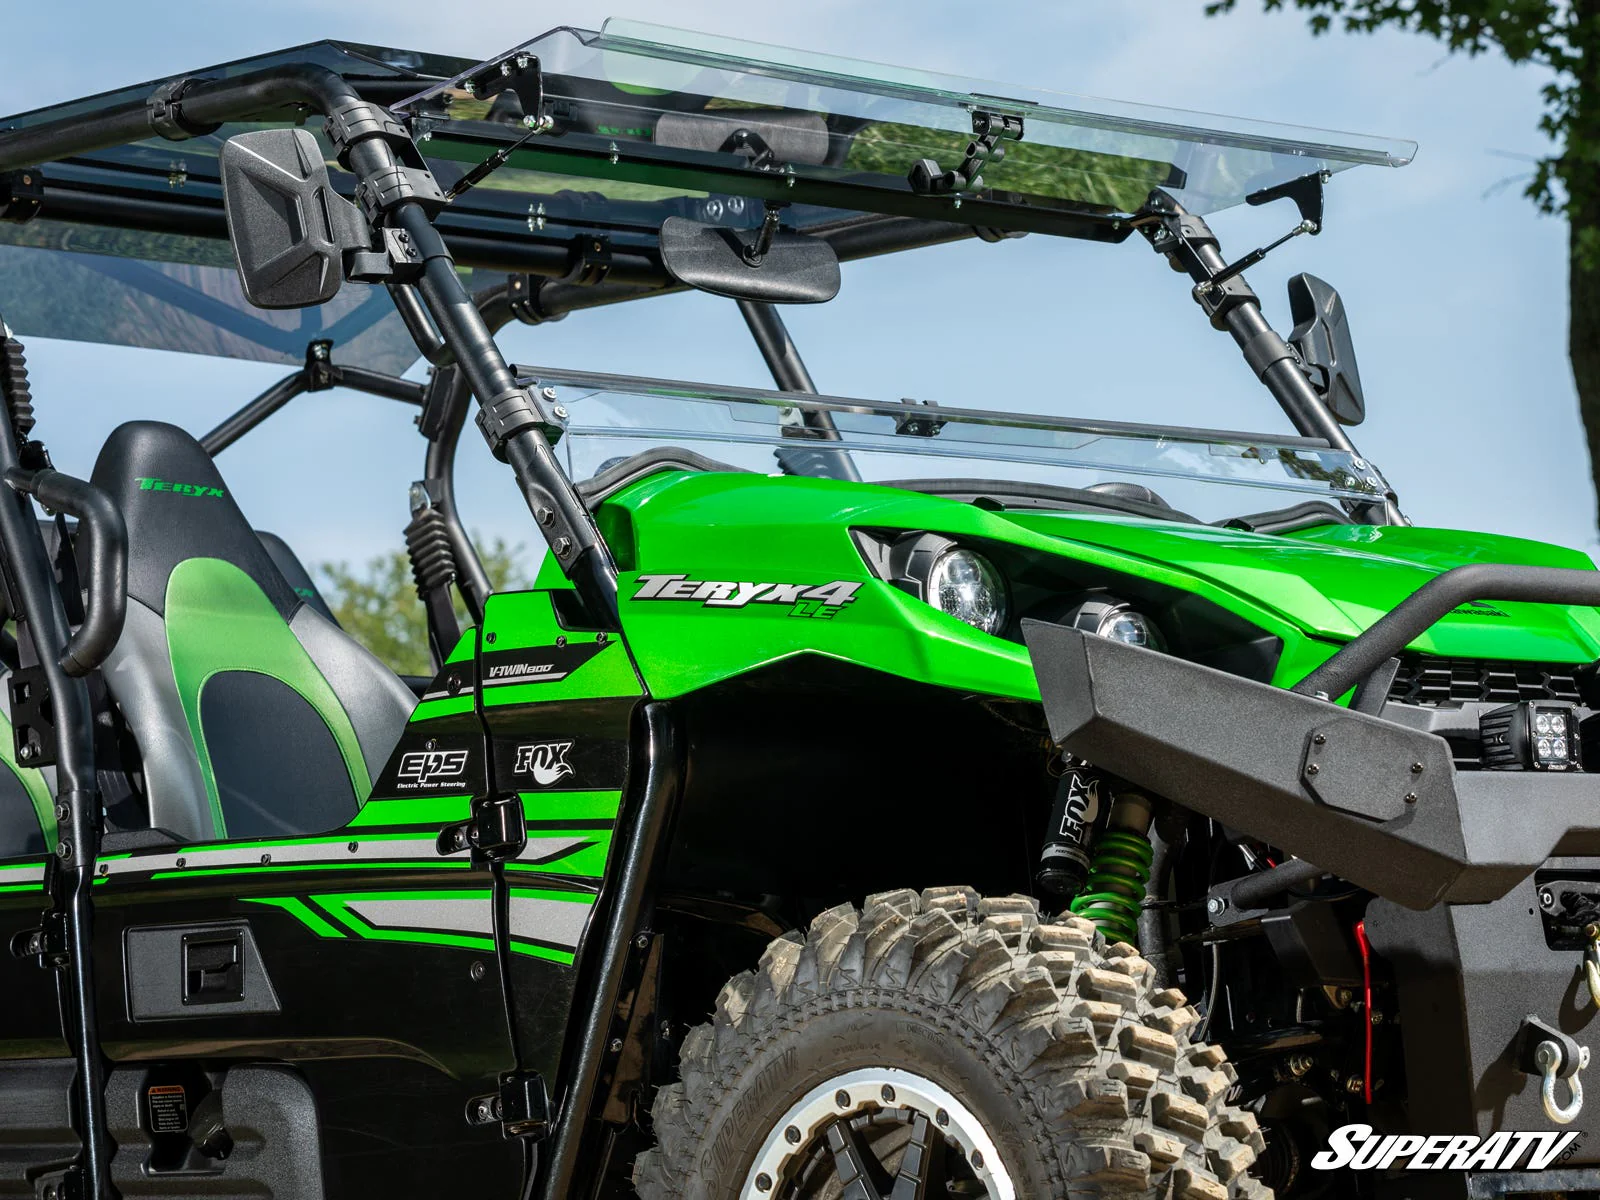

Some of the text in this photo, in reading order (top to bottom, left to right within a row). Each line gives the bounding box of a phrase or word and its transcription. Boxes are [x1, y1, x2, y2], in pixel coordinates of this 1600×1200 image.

[134, 477, 224, 497] TERYX
[630, 574, 864, 608] TERYX4
[788, 601, 846, 619] LE
[398, 750, 468, 783] EPS
[514, 742, 573, 784] FOX
[440, 780, 466, 788] Steering
[1059, 774, 1096, 844] FOX
